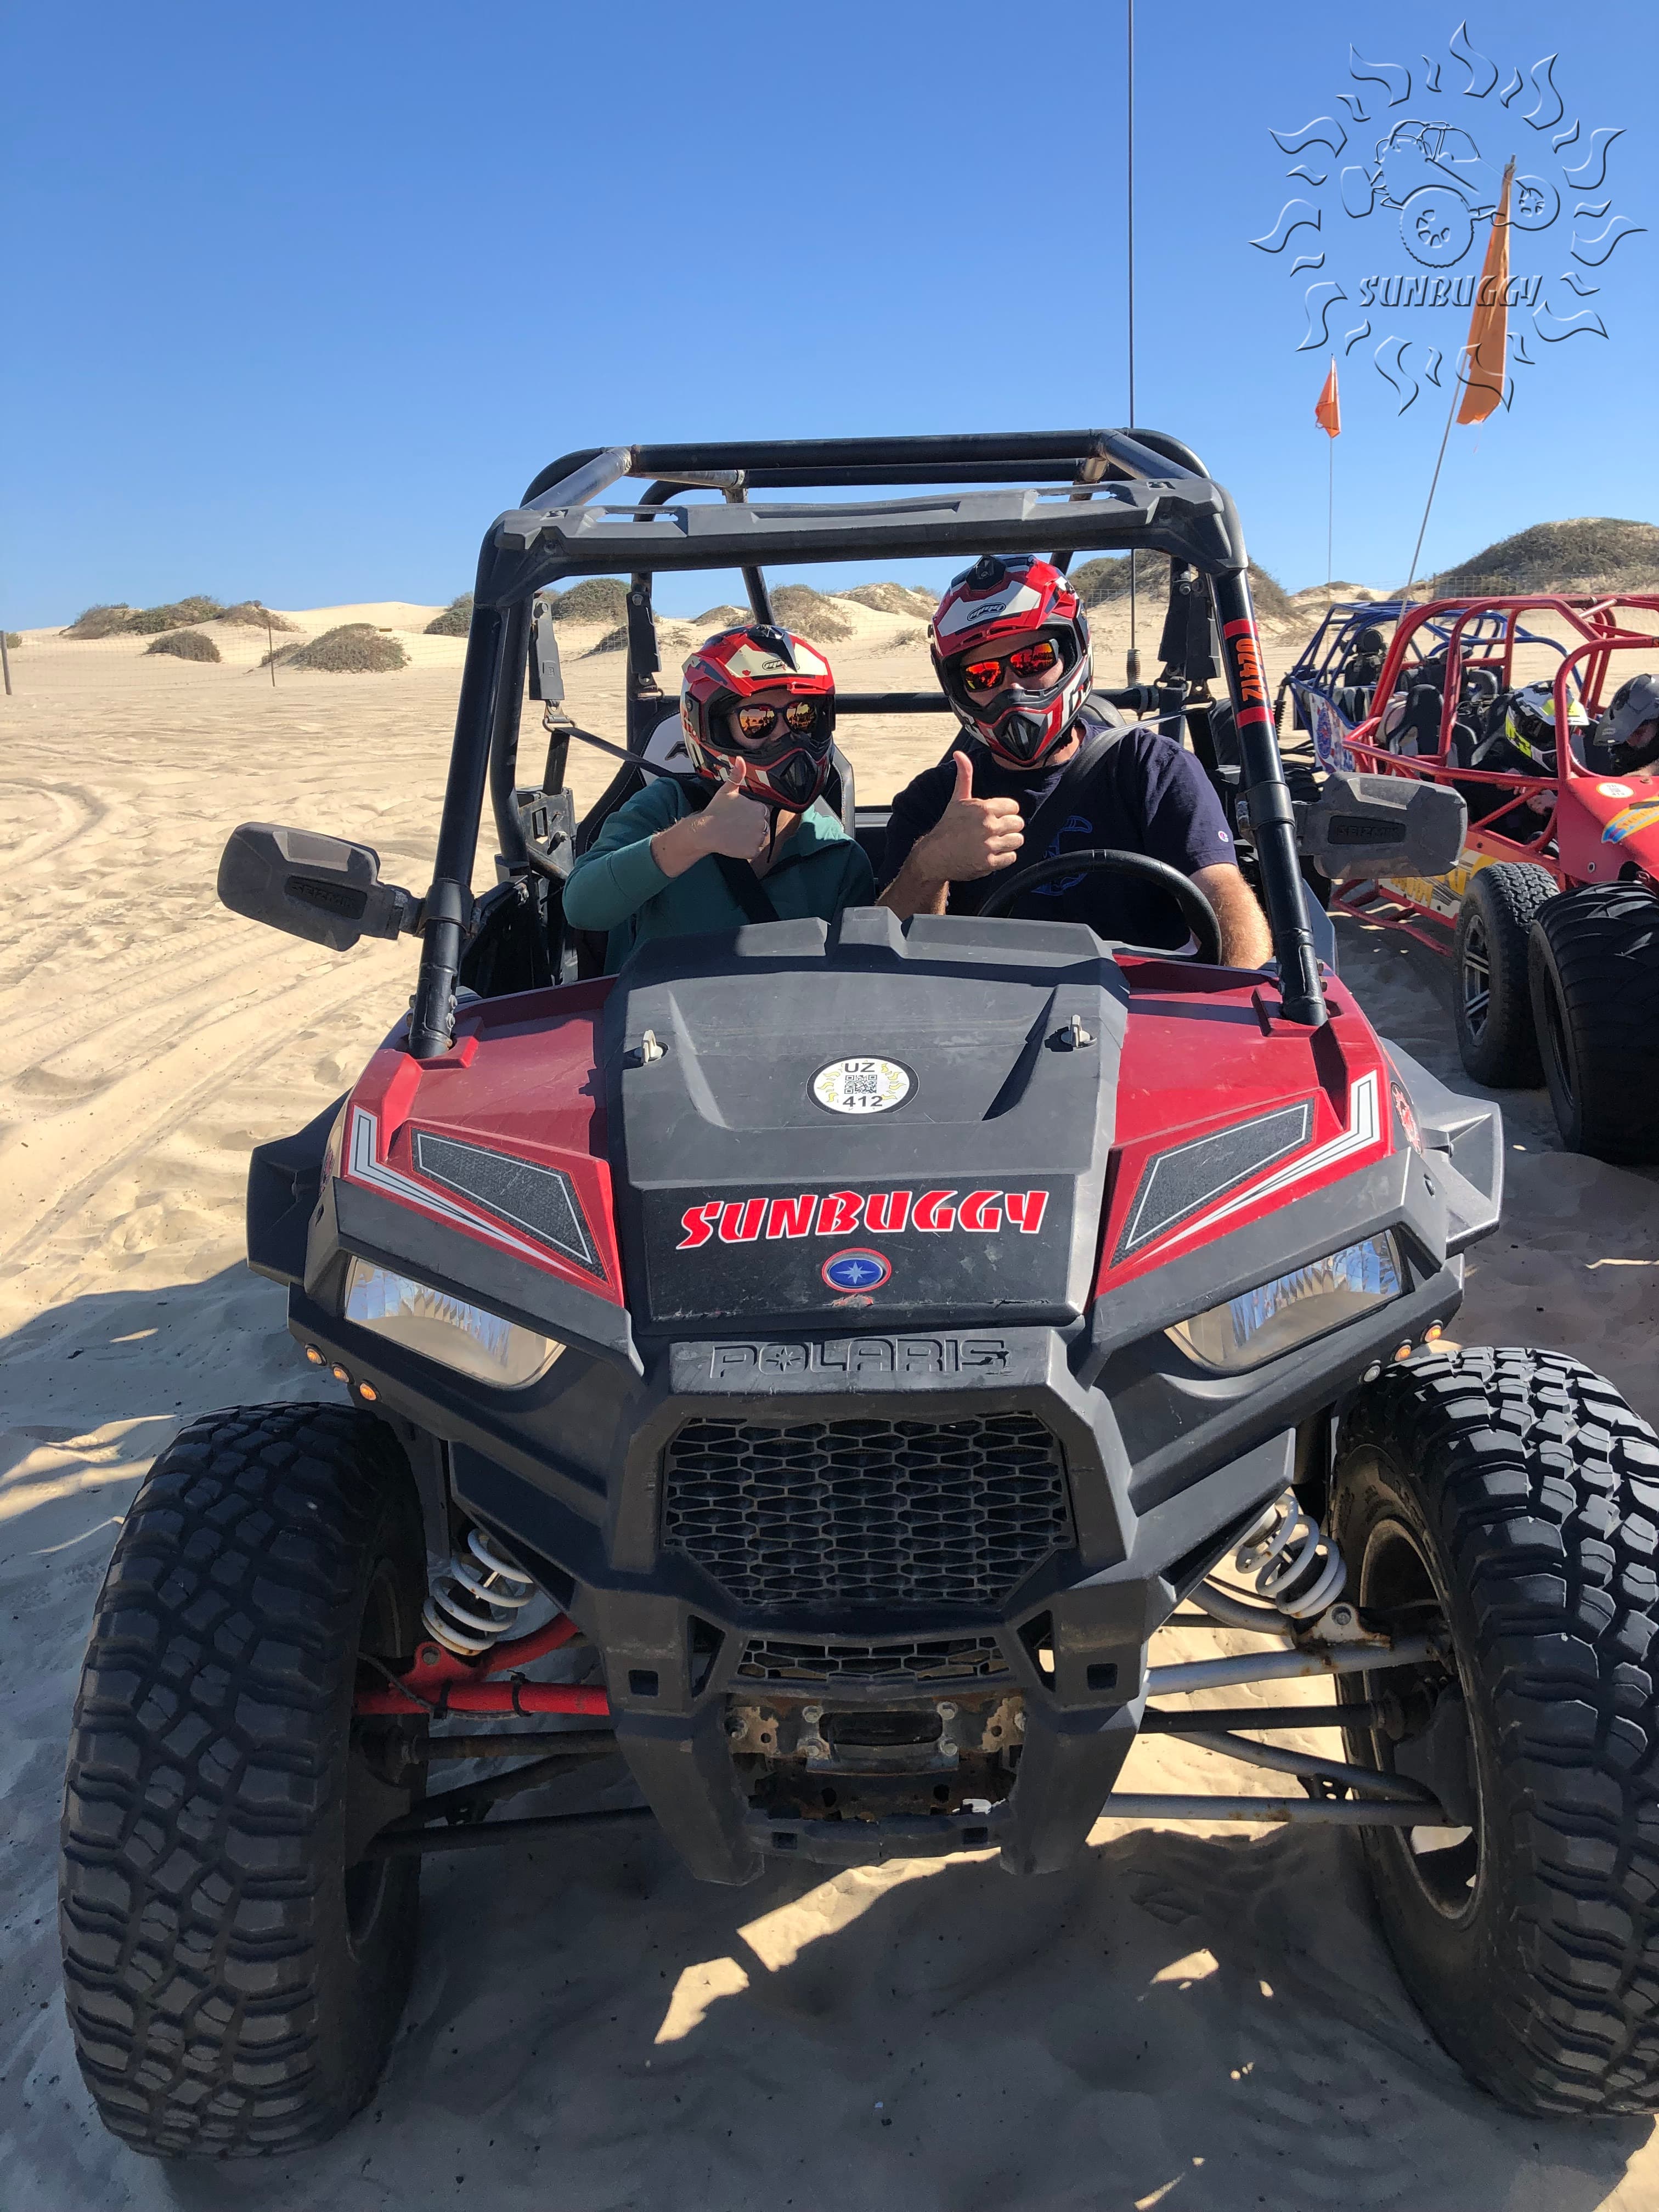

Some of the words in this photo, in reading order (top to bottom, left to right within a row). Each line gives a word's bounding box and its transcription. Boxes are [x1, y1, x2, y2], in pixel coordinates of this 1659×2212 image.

[844, 1062, 876, 1073] UZ
[843, 1096, 883, 1107] 412
[676, 1190, 1049, 1250] SUNBUGGY
[710, 1339, 1009, 1378] POLARIS
